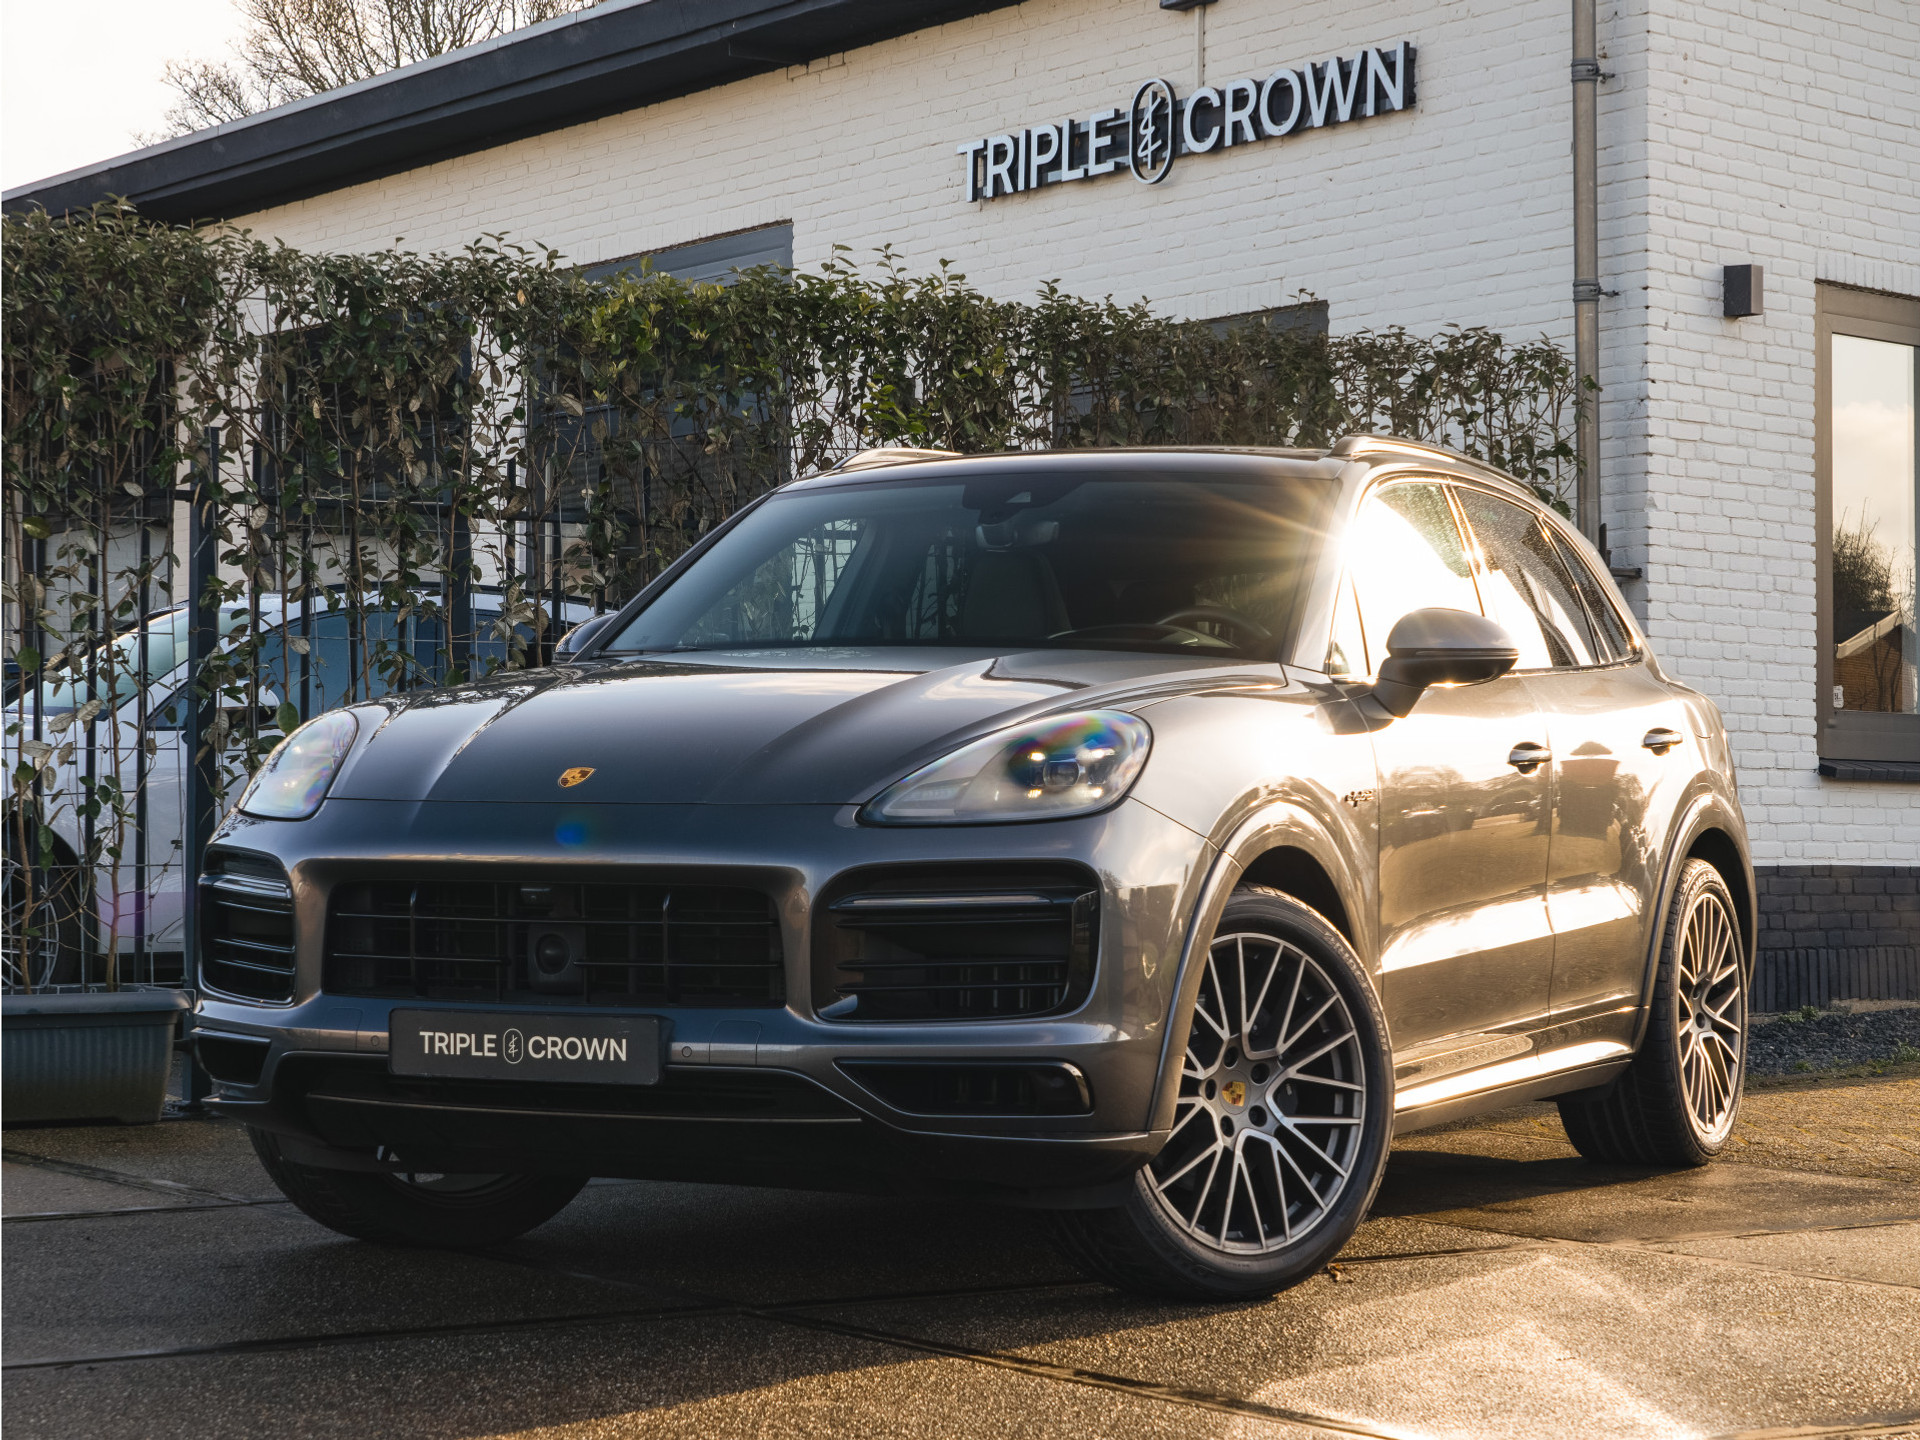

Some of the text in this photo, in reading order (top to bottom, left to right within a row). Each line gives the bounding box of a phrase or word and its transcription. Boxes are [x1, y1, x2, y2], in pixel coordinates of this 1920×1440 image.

[957, 41, 1412, 202] TRIPLE CROWN
[419, 1031, 627, 1062] TRIPLE CROWN
